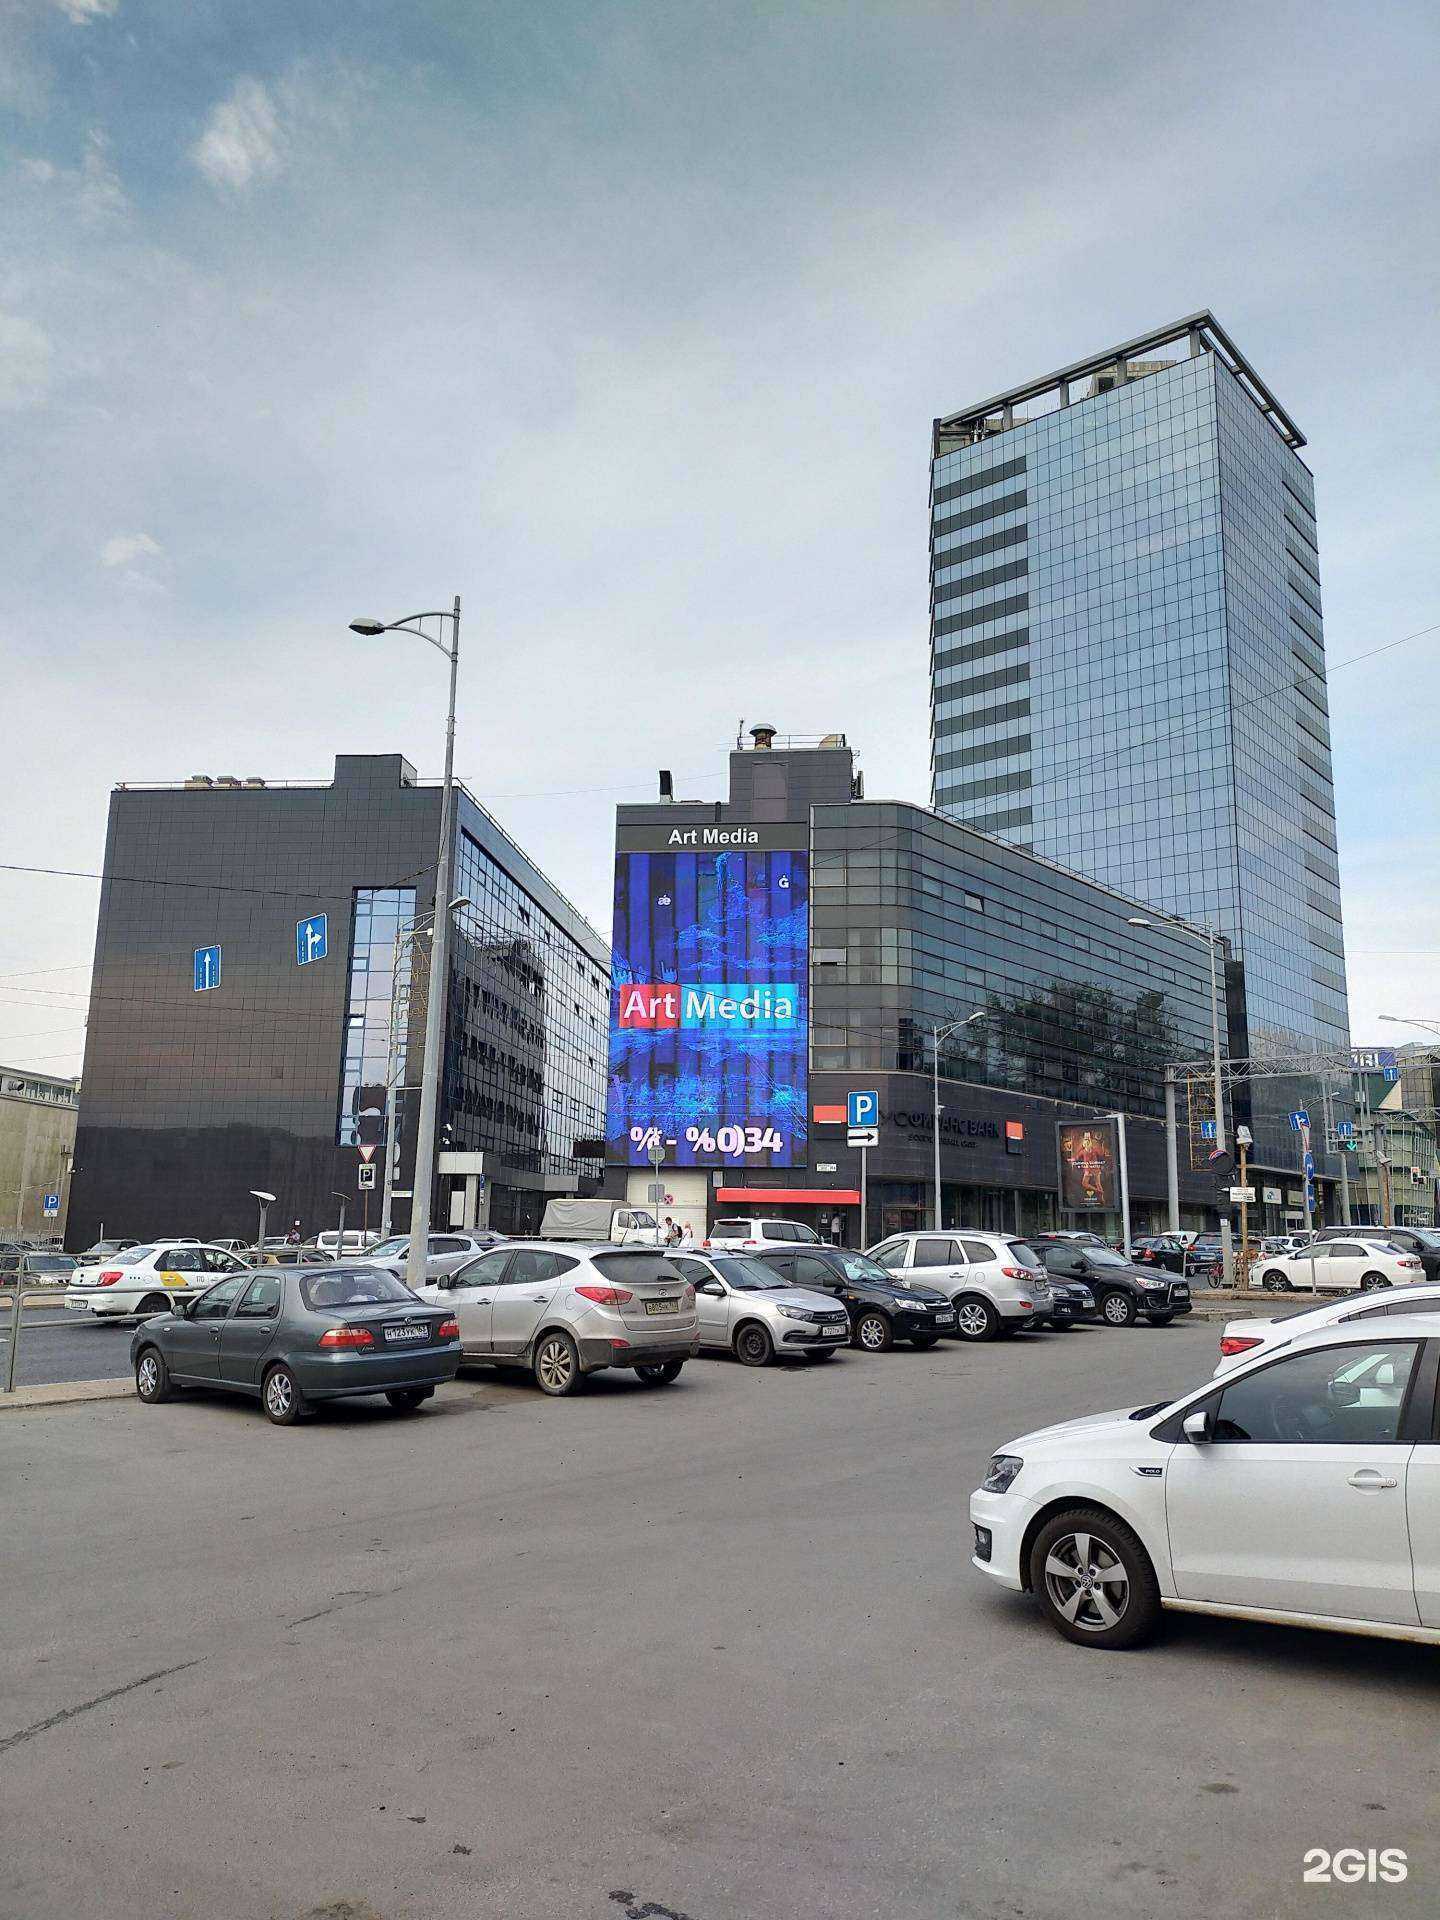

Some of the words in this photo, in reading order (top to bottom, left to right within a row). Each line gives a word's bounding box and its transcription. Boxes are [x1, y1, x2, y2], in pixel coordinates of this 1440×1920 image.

[668, 828, 698, 845] Art
[703, 828, 759, 844] Media
[623, 990, 677, 1019] Art
[686, 990, 792, 1020] Media
[856, 1095, 873, 1123] P
